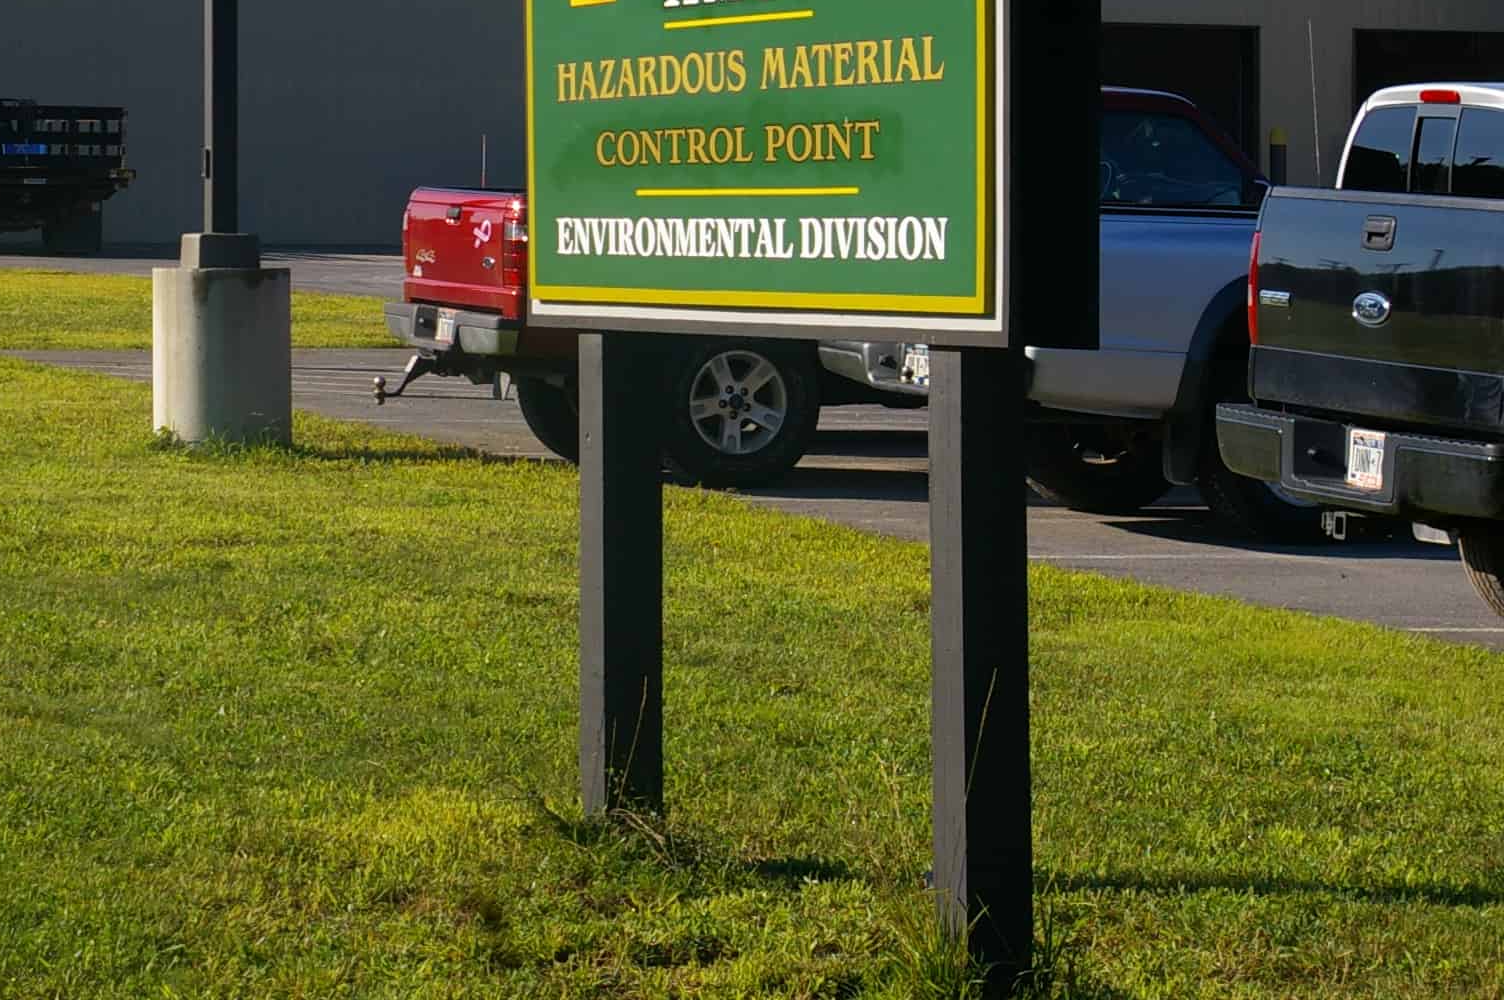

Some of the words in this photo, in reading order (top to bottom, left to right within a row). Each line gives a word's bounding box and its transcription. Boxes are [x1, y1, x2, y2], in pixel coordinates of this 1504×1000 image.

[556, 49, 746, 102] HAZARDOUS
[759, 35, 945, 90] MATERIAL
[595, 125, 754, 166] CONTROL
[763, 119, 881, 162] POINT
[556, 216, 794, 259] ENVIRONMENTAL
[799, 215, 949, 261] DIVISION
